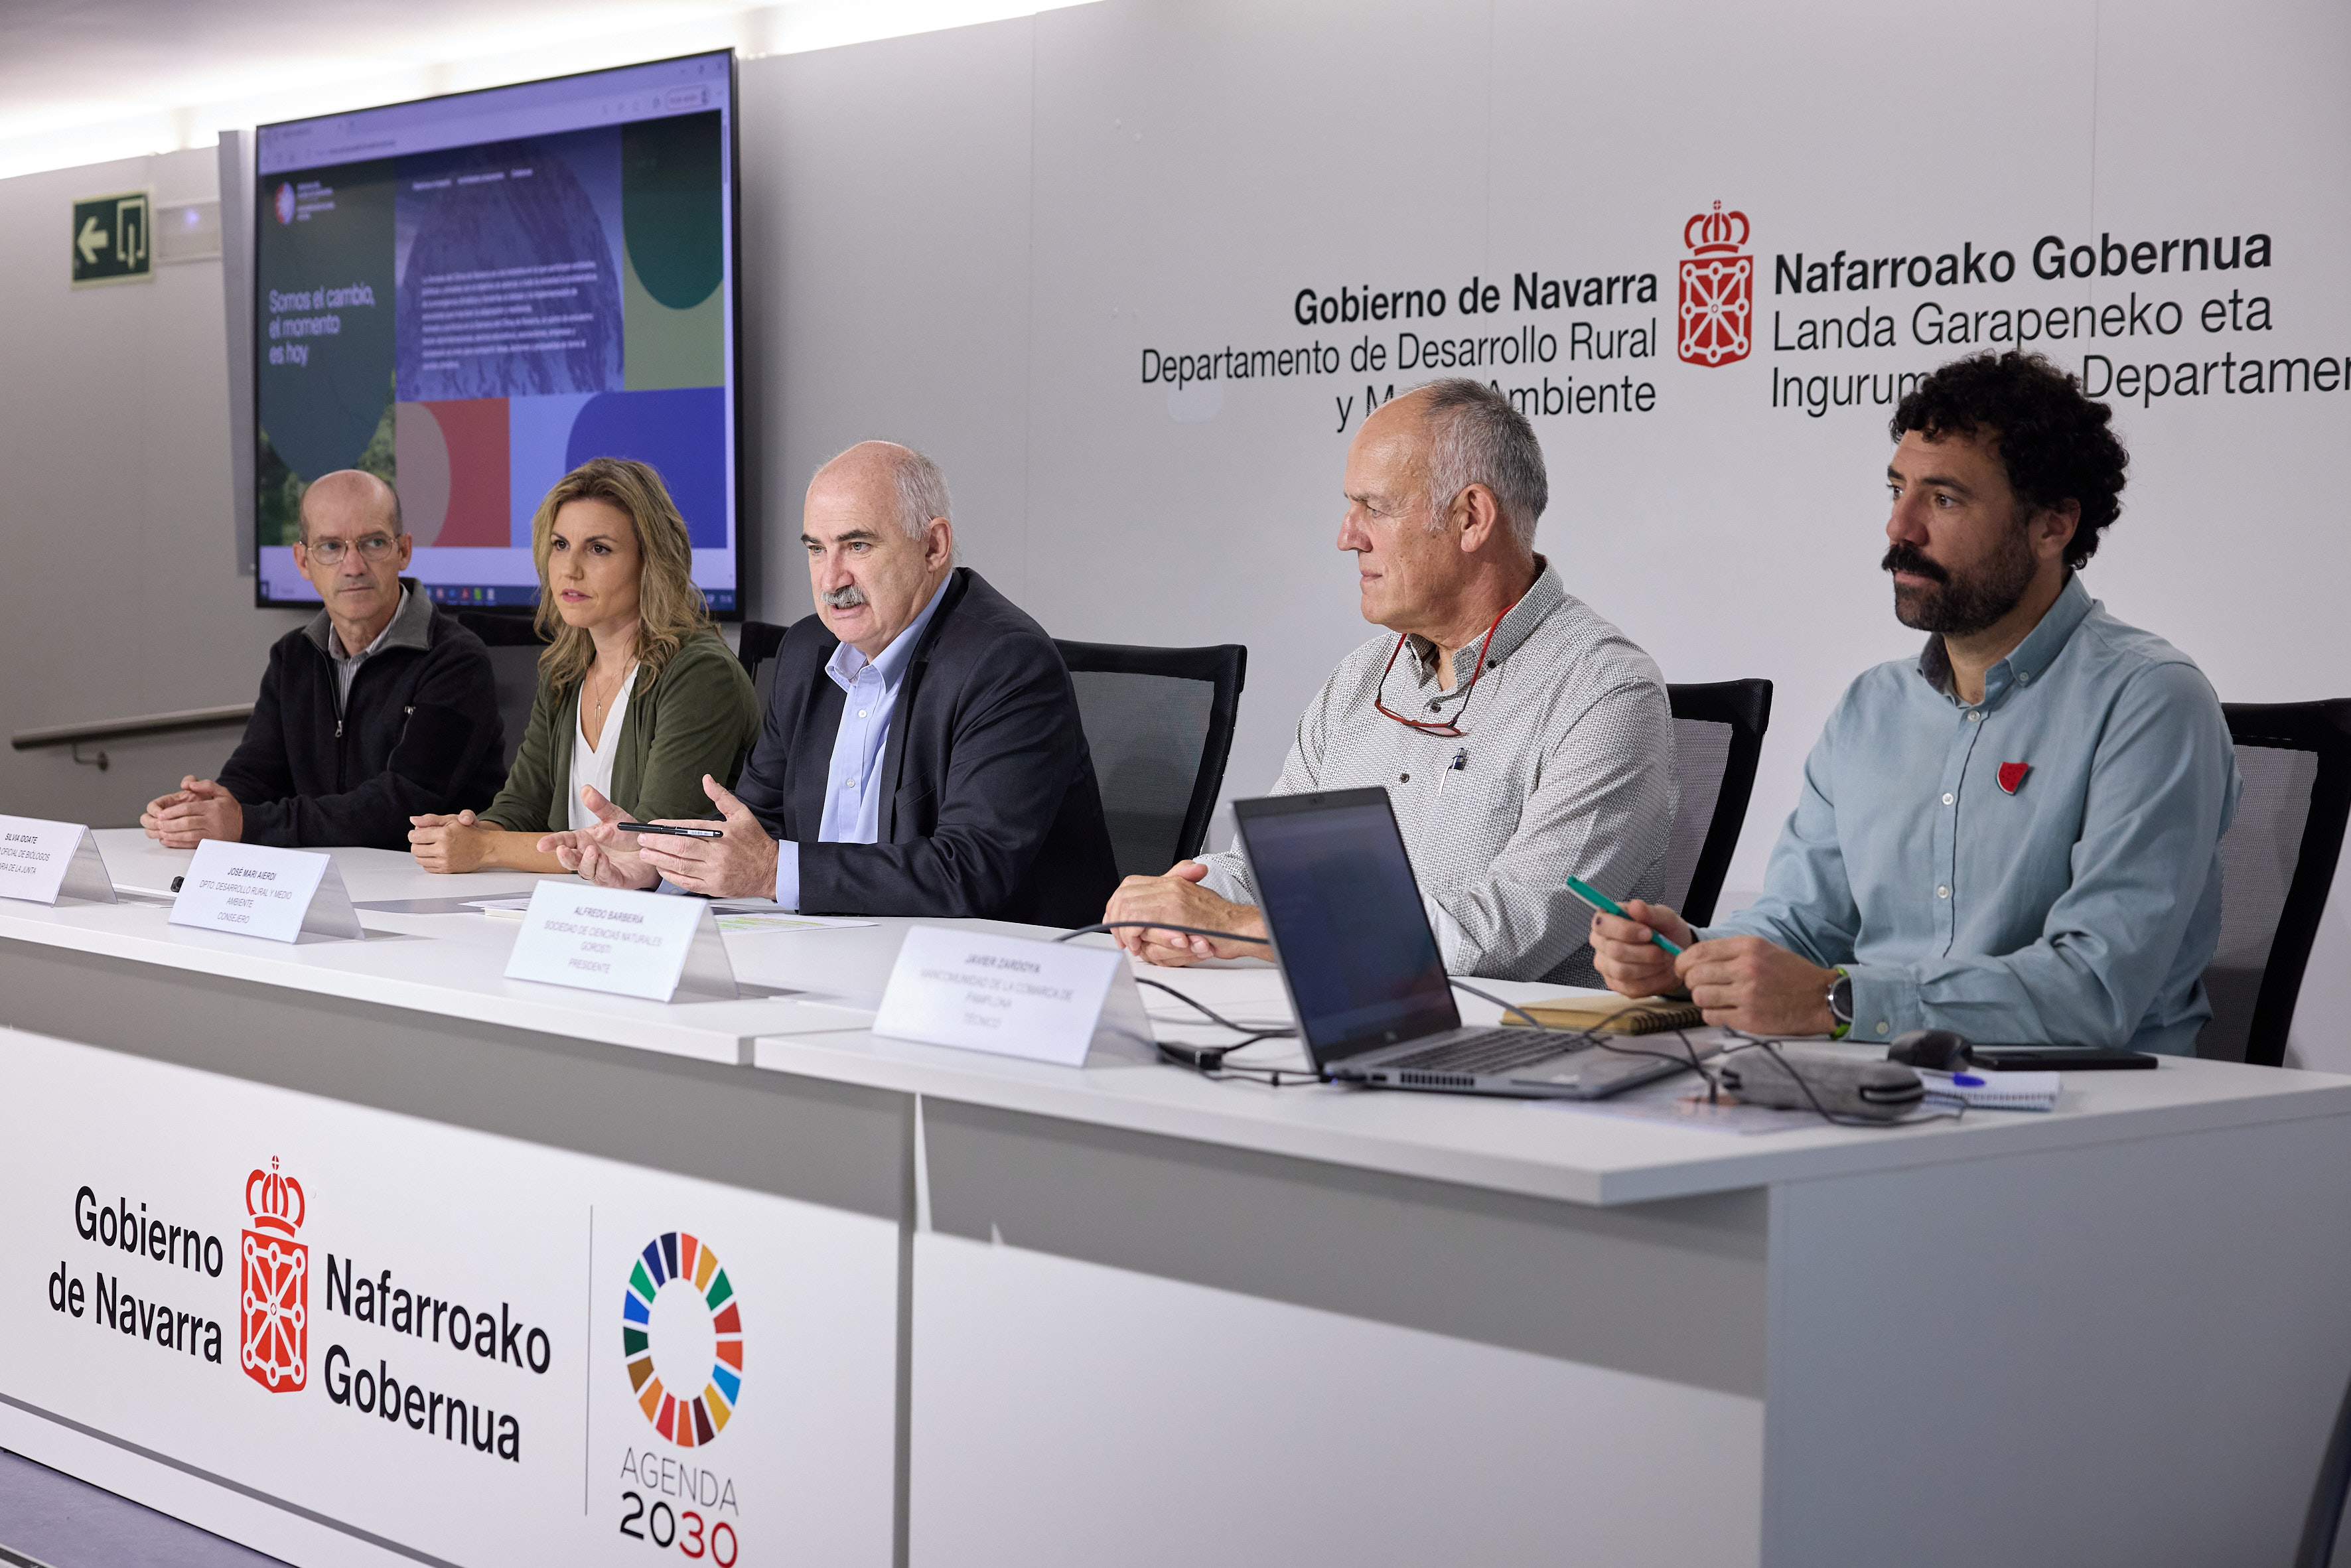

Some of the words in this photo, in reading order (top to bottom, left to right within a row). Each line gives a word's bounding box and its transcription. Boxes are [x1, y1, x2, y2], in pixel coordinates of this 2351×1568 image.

[1775, 242, 2016, 295] Nafarroako
[2032, 232, 2273, 280] Gobernua
[269, 289, 312, 313] Somos
[313, 285, 325, 310] el
[1295, 285, 1447, 325] Gobierno
[1459, 276, 1500, 315] de
[1514, 272, 1658, 311] Navarra
[269, 315, 281, 339] el
[282, 313, 341, 337] momento
[1774, 306, 1896, 351] Landa
[1912, 292, 2184, 352] Garapeneko
[2201, 289, 2273, 332] eta
[286, 340, 309, 367] hoy
[1142, 340, 1340, 391] Departamento
[1350, 335, 1387, 372] de
[1399, 324, 1557, 370] Desarrollo
[1571, 317, 1657, 361] Rural
[2083, 352, 2351, 409] Departame
[1336, 395, 1354, 433] y
[1490, 376, 1656, 415] mbiente
[1, 848, 18, 857] OFICIAL
[25, 850, 50, 861] BIÓLOGOS
[5, 833, 20, 842] SILVIA
[20, 835, 38, 844] IDOATE
[21, 866, 36, 875] JUNTA
[199, 880, 215, 889] DPTO.
[215, 882, 251, 894] DESARROLLO
[251, 887, 268, 896] RURAL
[274, 891, 292, 900] MEDIO
[228, 867, 243, 877] JOSÉ
[243, 869, 257, 878] MARI
[257, 871, 277, 881] AIERDI
[217, 912, 250, 924] CONSEJERO
[226, 897, 253, 908] AMBIENTE
[573, 906, 607, 918] ALFREDO
[544, 920, 578, 933] SOCIEDAD
[578, 925, 589, 936] DE
[588, 926, 620, 940] CIENCIAS
[621, 933, 664, 947] NATURALES
[75, 1186, 223, 1278] Gobierno
[48, 1260, 85, 1318] de
[96, 1271, 222, 1365] Navarra
[326, 1253, 551, 1374] Nafarroako
[324, 1344, 520, 1464] Gobernua
[620, 1447, 739, 1517] AGENDA
[620, 1491, 738, 1568] 2030
